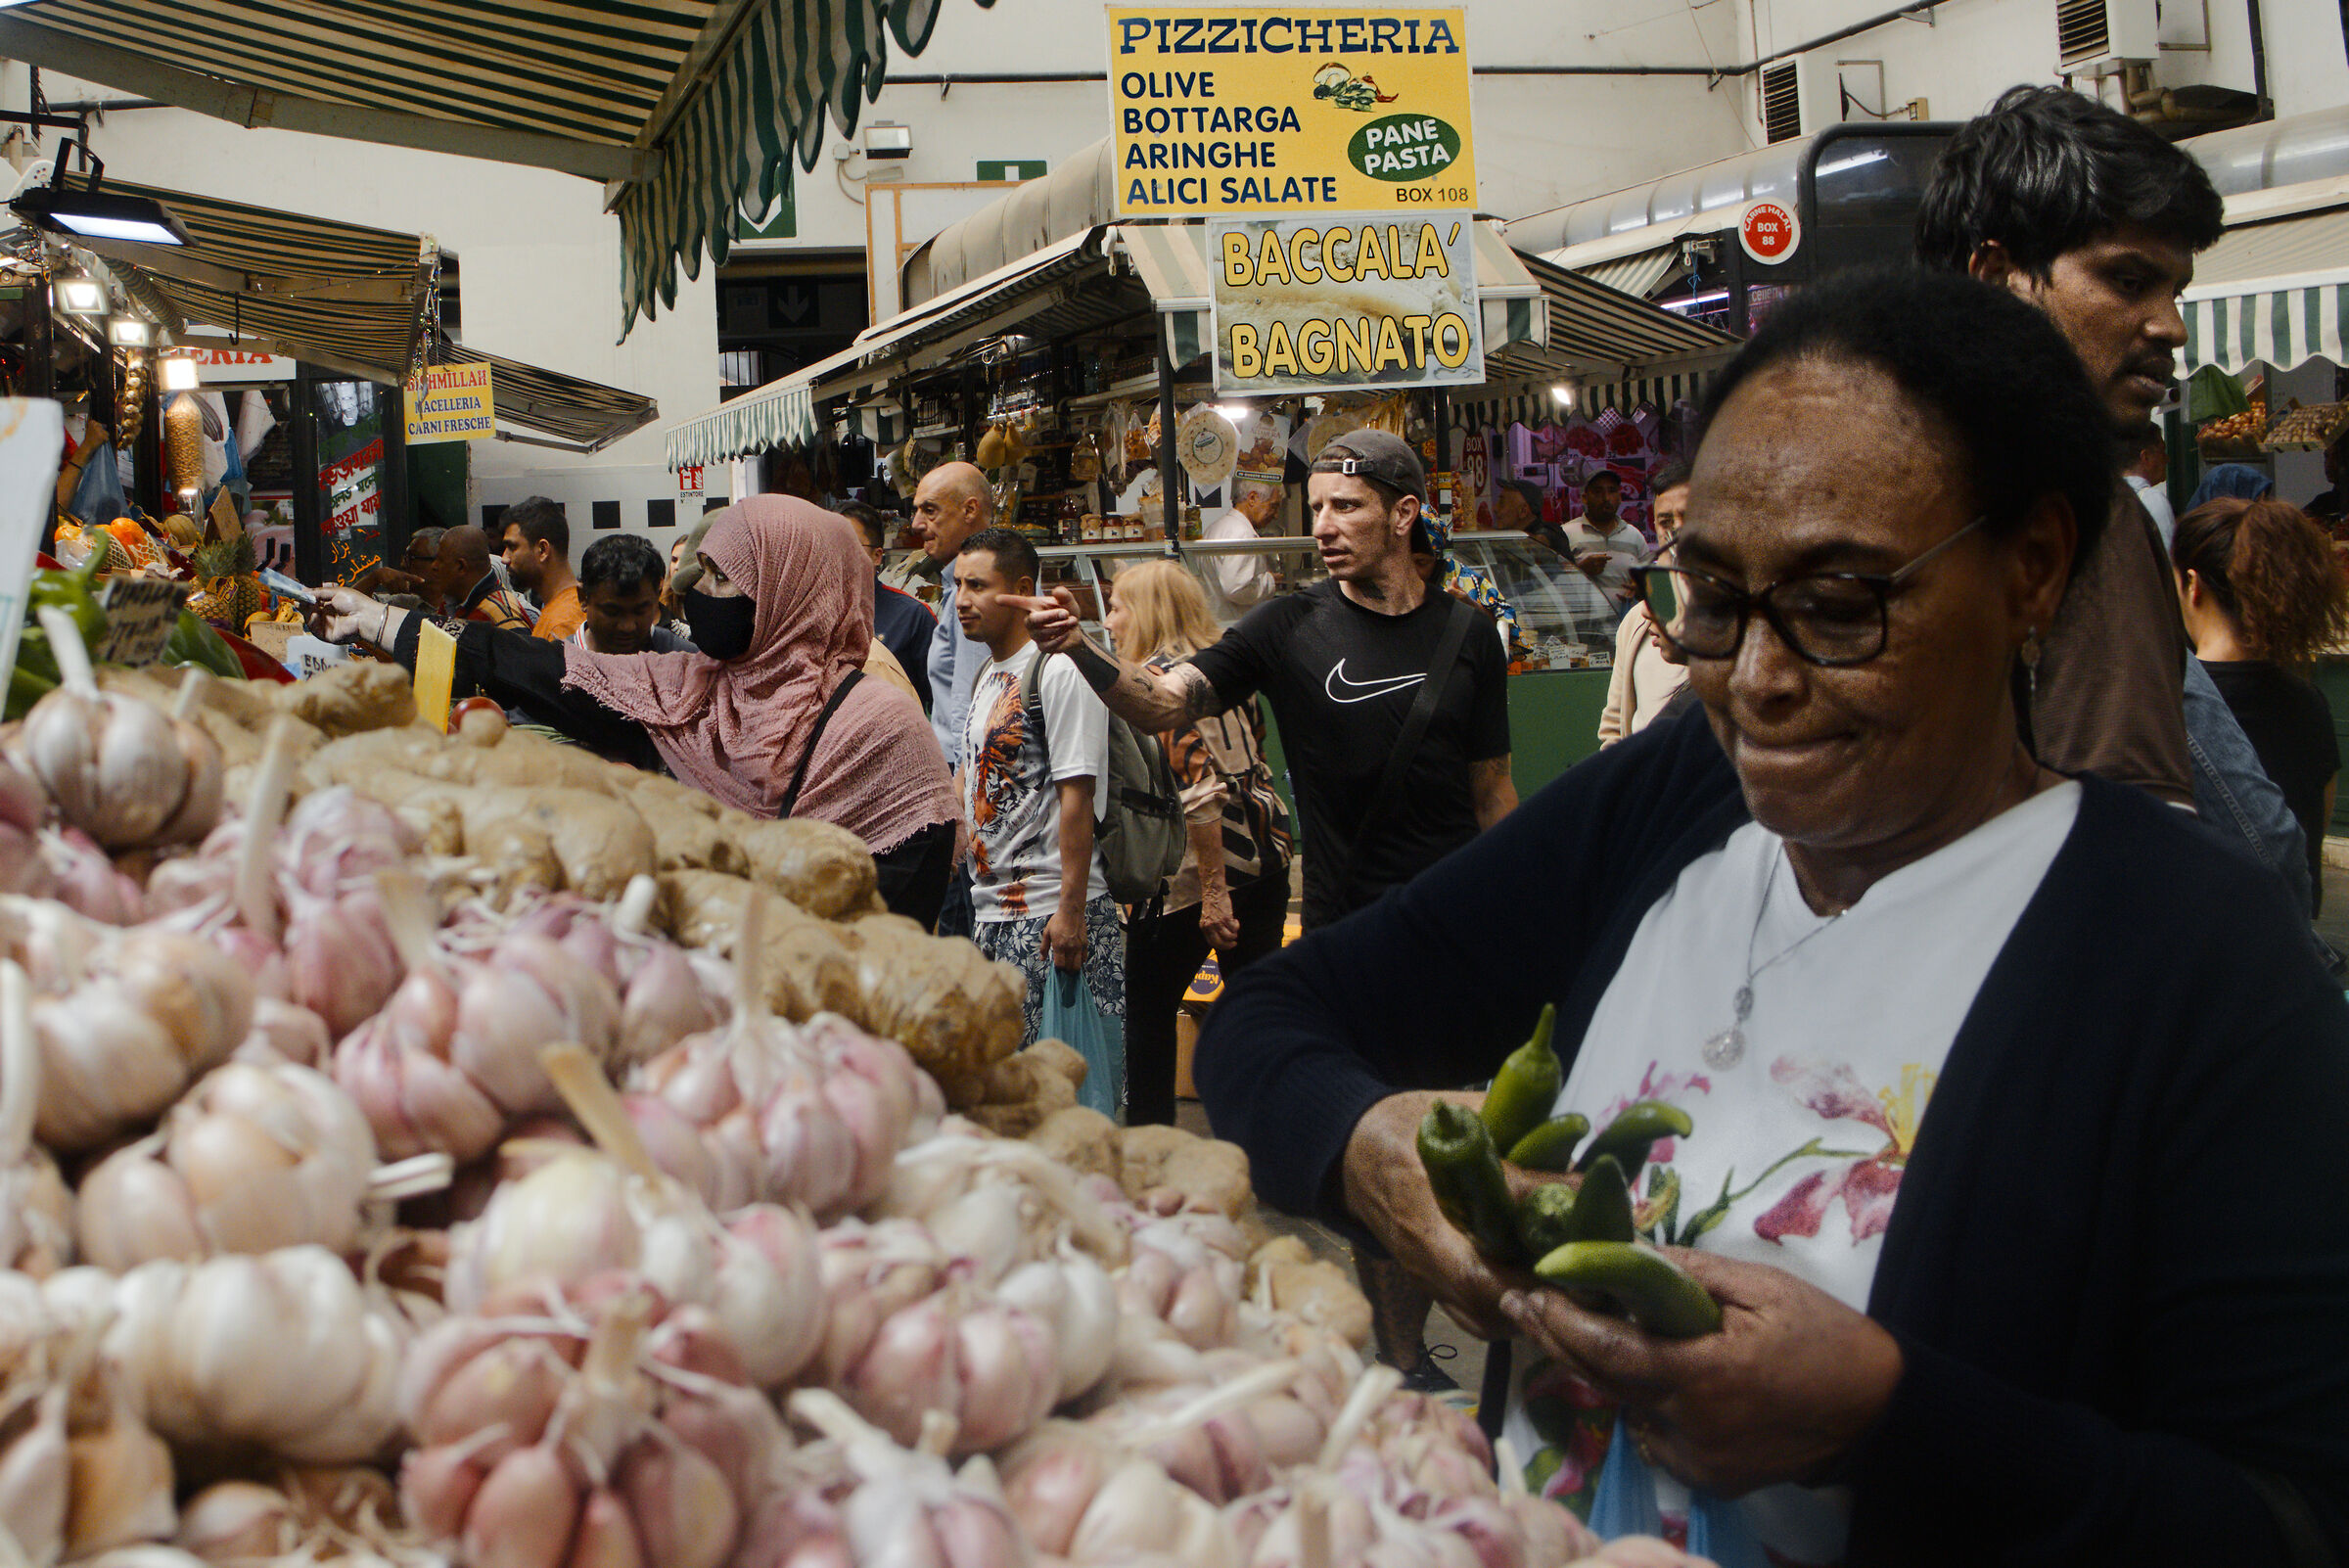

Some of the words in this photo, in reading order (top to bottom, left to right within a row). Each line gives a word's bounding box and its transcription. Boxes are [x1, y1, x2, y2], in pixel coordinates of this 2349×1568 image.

[1118, 18, 1460, 54] PIZZICHERIA
[1121, 71, 1215, 99] OLIVE
[1124, 106, 1301, 134] BOTTARGA
[1365, 118, 1439, 150] PANE
[1125, 142, 1276, 169] ARINGHE
[1364, 145, 1451, 175] PASTA
[1127, 177, 1208, 206] ALICI
[1221, 176, 1337, 204] SALATE
[1396, 188, 1433, 203] BOX
[1438, 187, 1469, 202] 108
[1744, 206, 1767, 232] CARNE
[1768, 206, 1791, 232] HALAL
[1757, 222, 1778, 233] BOX
[1762, 236, 1775, 246] 88
[1229, 312, 1470, 379] BAGNATO
[414, 396, 482, 414] MACELLERIA
[408, 420, 442, 436] CARNI
[444, 416, 491, 433] FRESCHE
[1466, 437, 1483, 451] BOX
